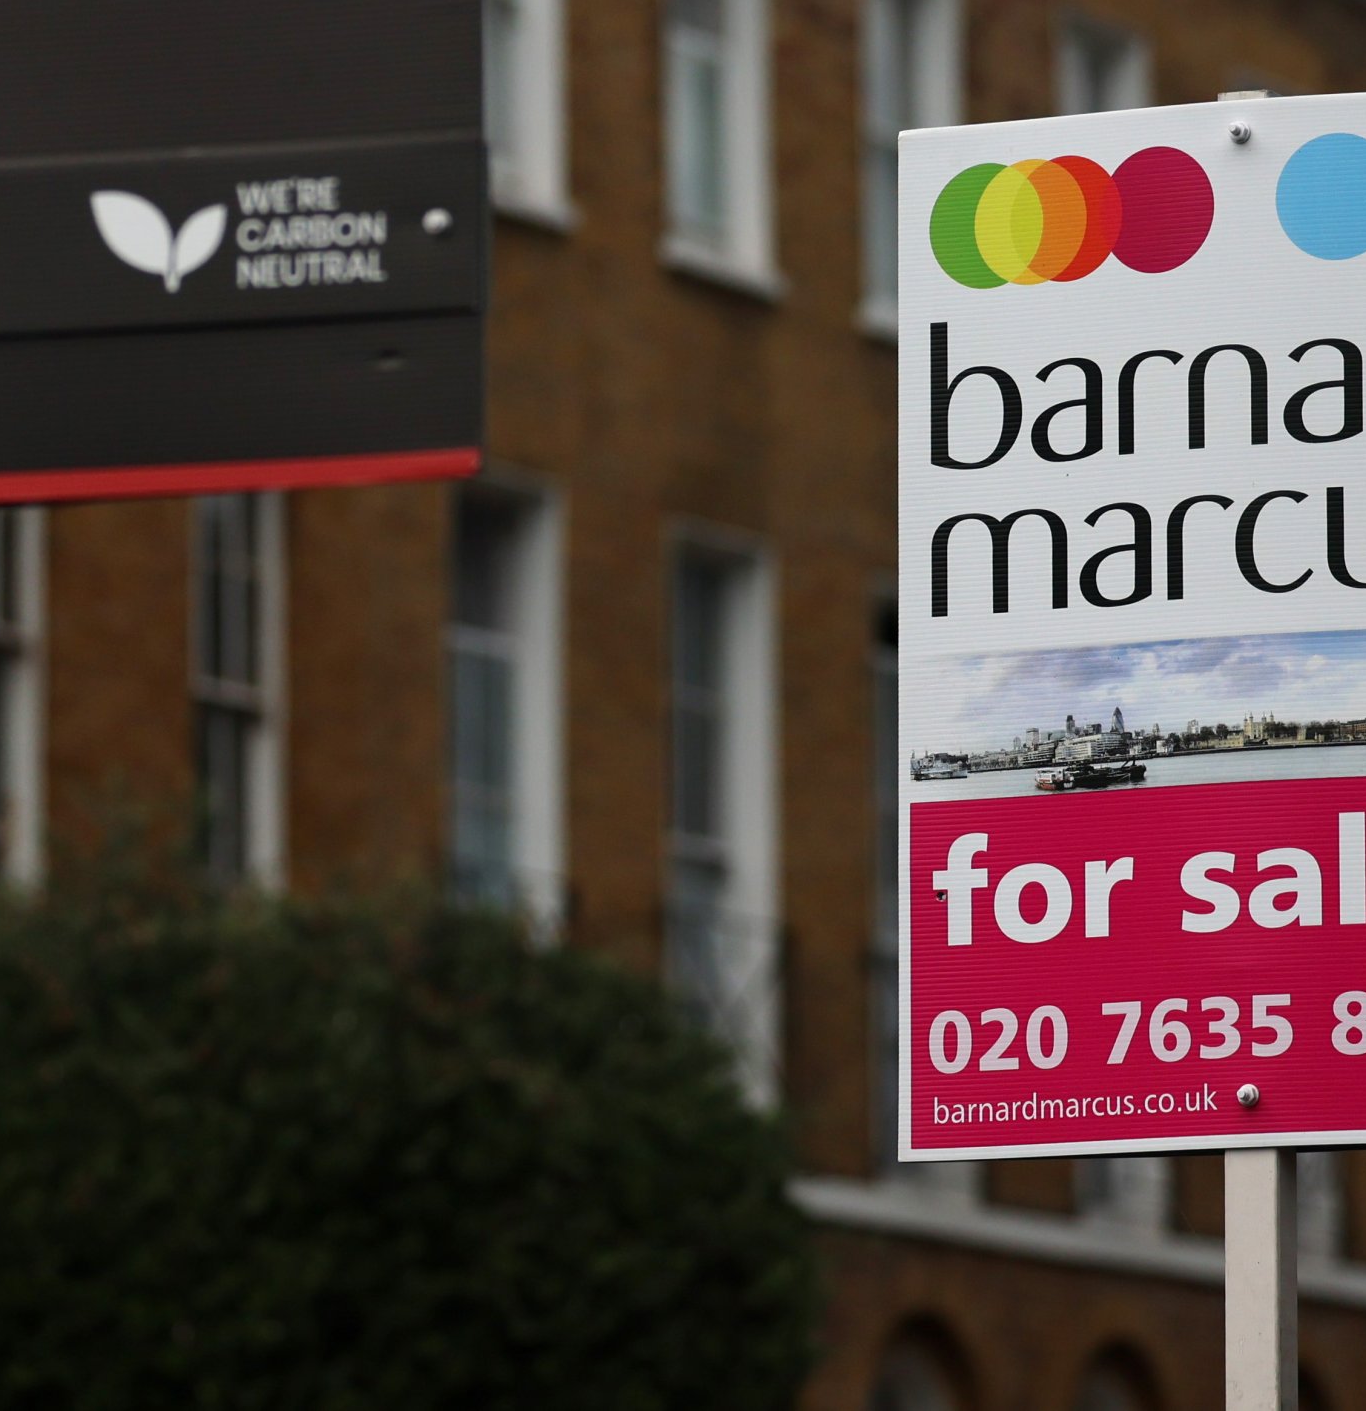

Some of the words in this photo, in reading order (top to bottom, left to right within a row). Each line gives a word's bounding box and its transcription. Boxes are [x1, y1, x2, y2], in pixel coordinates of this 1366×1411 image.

[236, 177, 339, 214] WE'RE
[236, 212, 387, 252] CARBON
[235, 249, 388, 289] NEUTRAL
[933, 832, 1134, 947] for
[928, 1004, 1069, 1075] 020
[1101, 993, 1294, 1065] 7635
[933, 1083, 1218, 1125] barnardmarcus.co.uk
